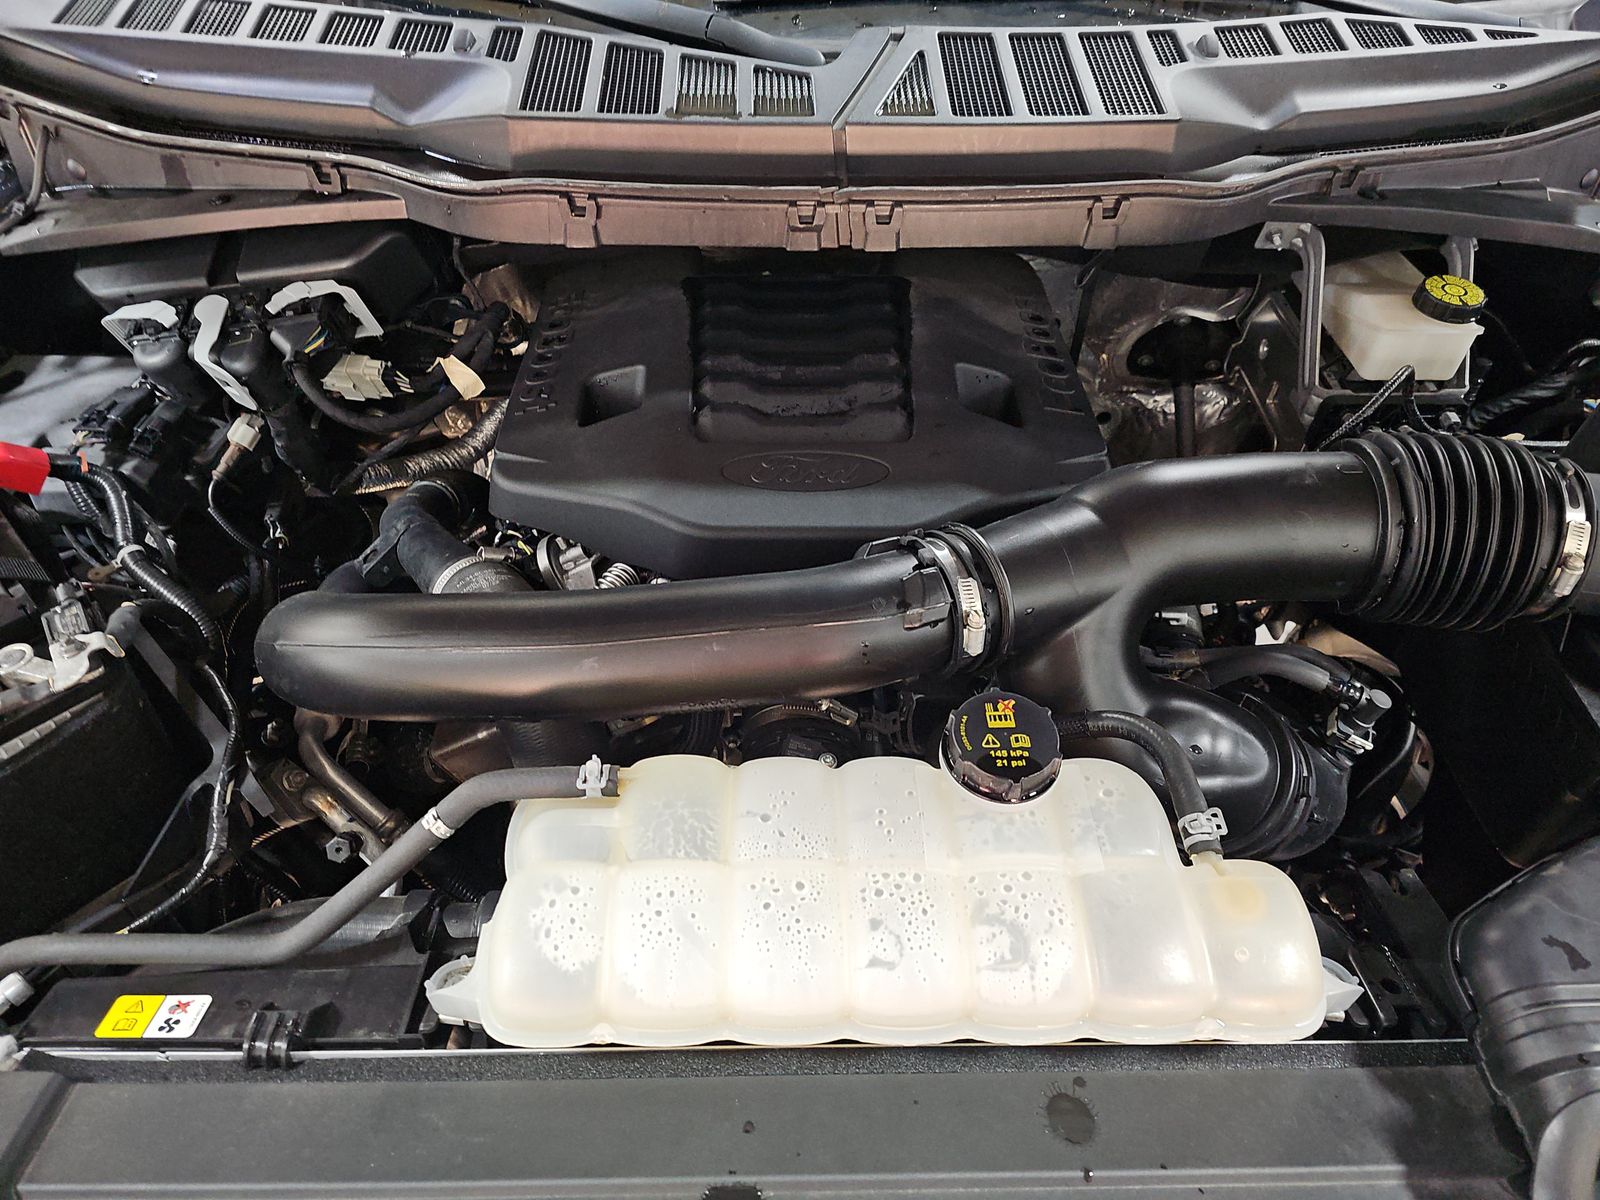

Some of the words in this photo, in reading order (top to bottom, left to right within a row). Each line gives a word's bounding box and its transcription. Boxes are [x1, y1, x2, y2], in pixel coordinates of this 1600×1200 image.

[749, 453, 861, 484] Ford
[996, 759, 1008, 767] 21
[1011, 759, 1027, 768] psi
